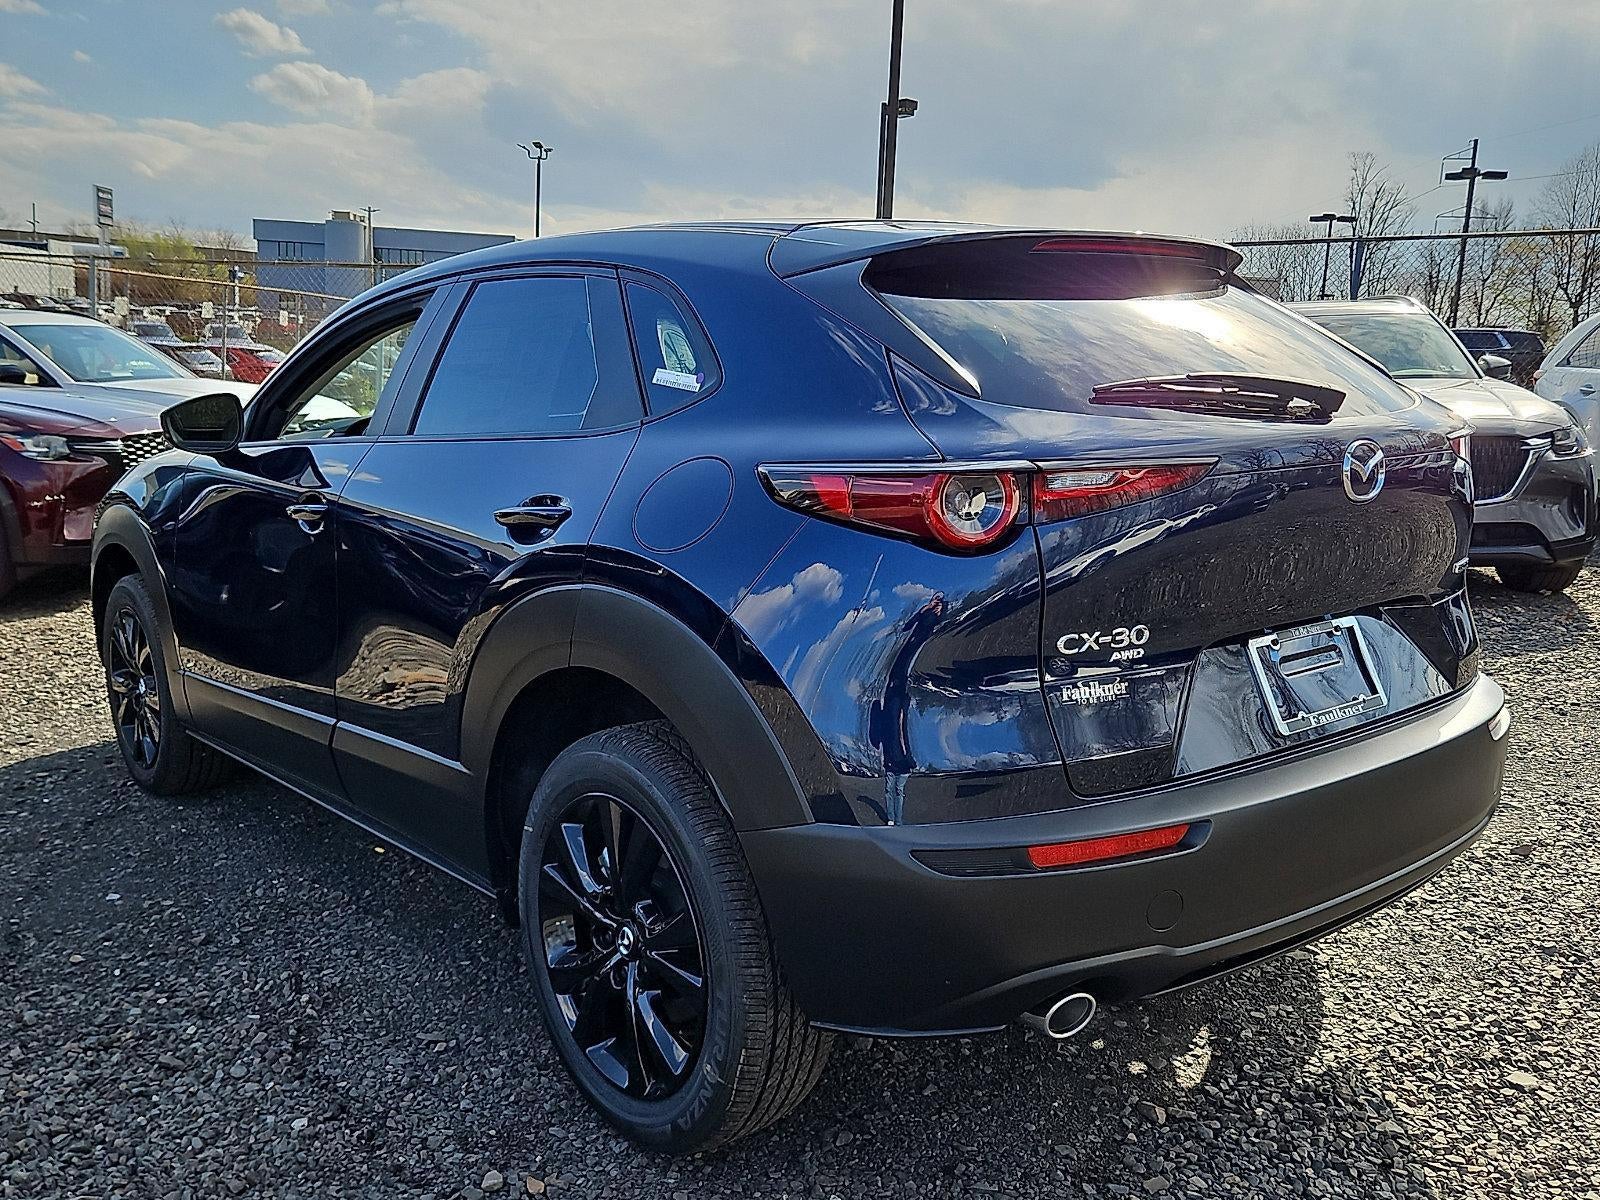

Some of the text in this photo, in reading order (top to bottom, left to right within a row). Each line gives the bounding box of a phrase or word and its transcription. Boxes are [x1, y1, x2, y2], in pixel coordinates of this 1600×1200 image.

[1056, 624, 1150, 655] CX-30
[1109, 648, 1145, 662] AWD
[1061, 680, 1129, 702] Faulkner
[1078, 694, 1116, 706] TO BE SURE
[1309, 702, 1364, 726] Faulkner
